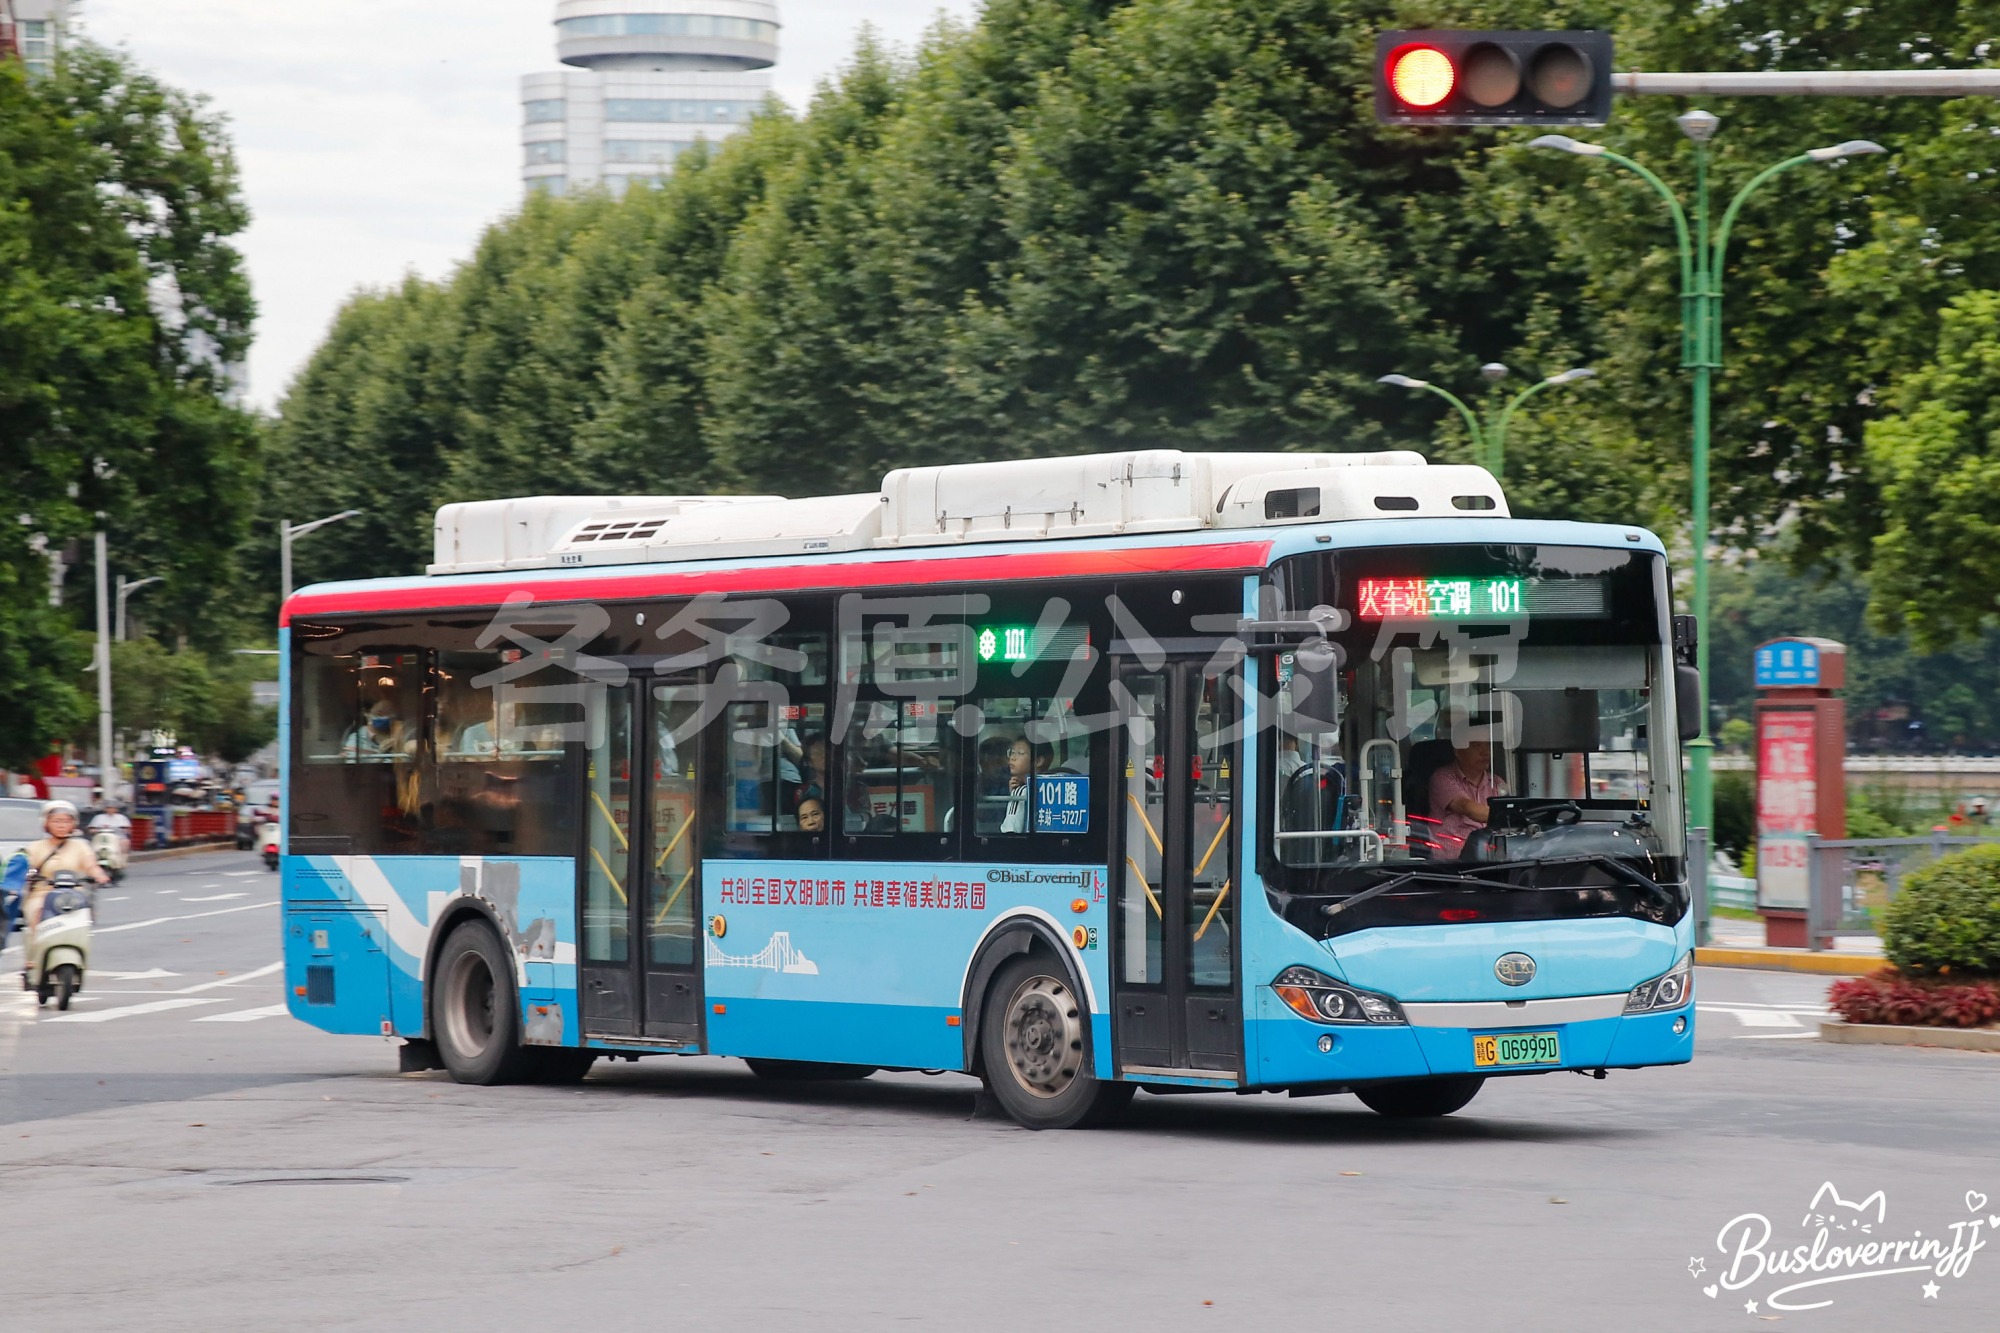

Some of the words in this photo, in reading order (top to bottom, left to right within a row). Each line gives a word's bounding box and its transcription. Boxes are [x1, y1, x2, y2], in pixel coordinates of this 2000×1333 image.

[1488, 581, 1520, 612] 101
[1004, 629, 1026, 659] 101
[1039, 782, 1077, 805] 101路
[721, 878, 846, 906] 共创全国文明城市
[854, 880, 985, 909] 共建幸福美好家园
